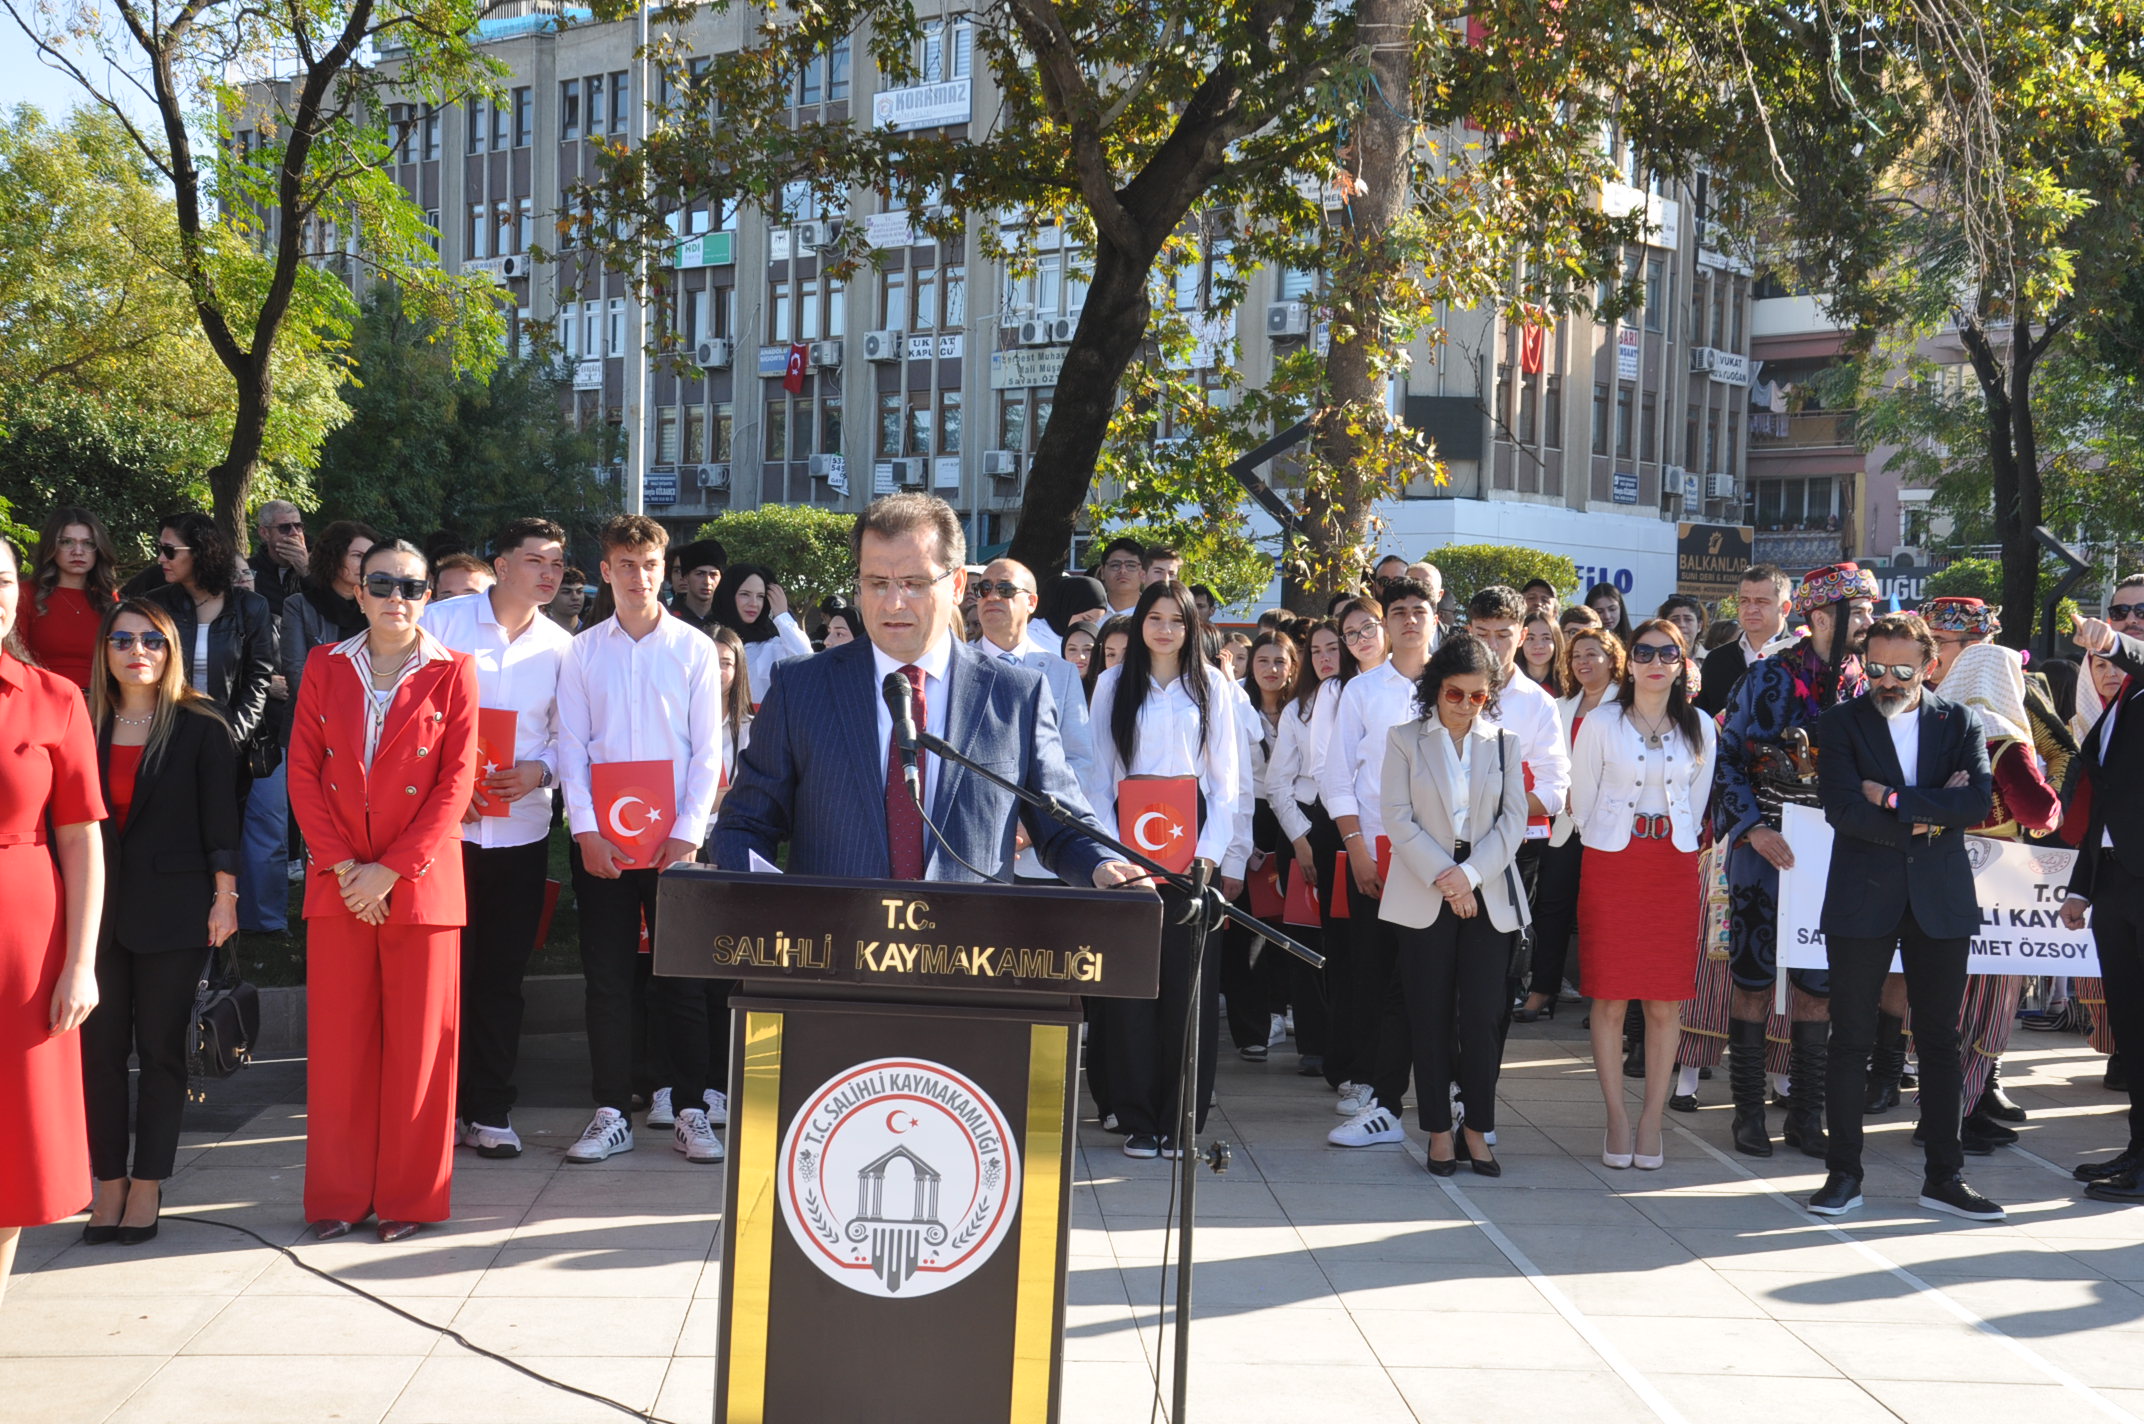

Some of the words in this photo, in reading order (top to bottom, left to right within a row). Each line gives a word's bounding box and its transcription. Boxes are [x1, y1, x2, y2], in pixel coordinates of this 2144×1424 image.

[895, 83, 967, 111] KORKMAZ
[684, 243, 700, 254] HDI
[760, 347, 788, 356] ANADOLU
[1720, 355, 1743, 368] VUKAT
[1679, 553, 1748, 573] BALKANLAR
[881, 899, 936, 931] T.C.
[2009, 908, 2062, 929] KAY
[712, 930, 832, 969] SALİHLİ
[855, 940, 1103, 982] KAYMAKAMLIĞI
[2018, 936, 2089, 960] ÖZSOY
[803, 1119, 833, 1145] T.C.
[823, 1071, 887, 1121] SALİHLİ
[889, 1072, 1000, 1156] KAYMAKAMLIĞI
